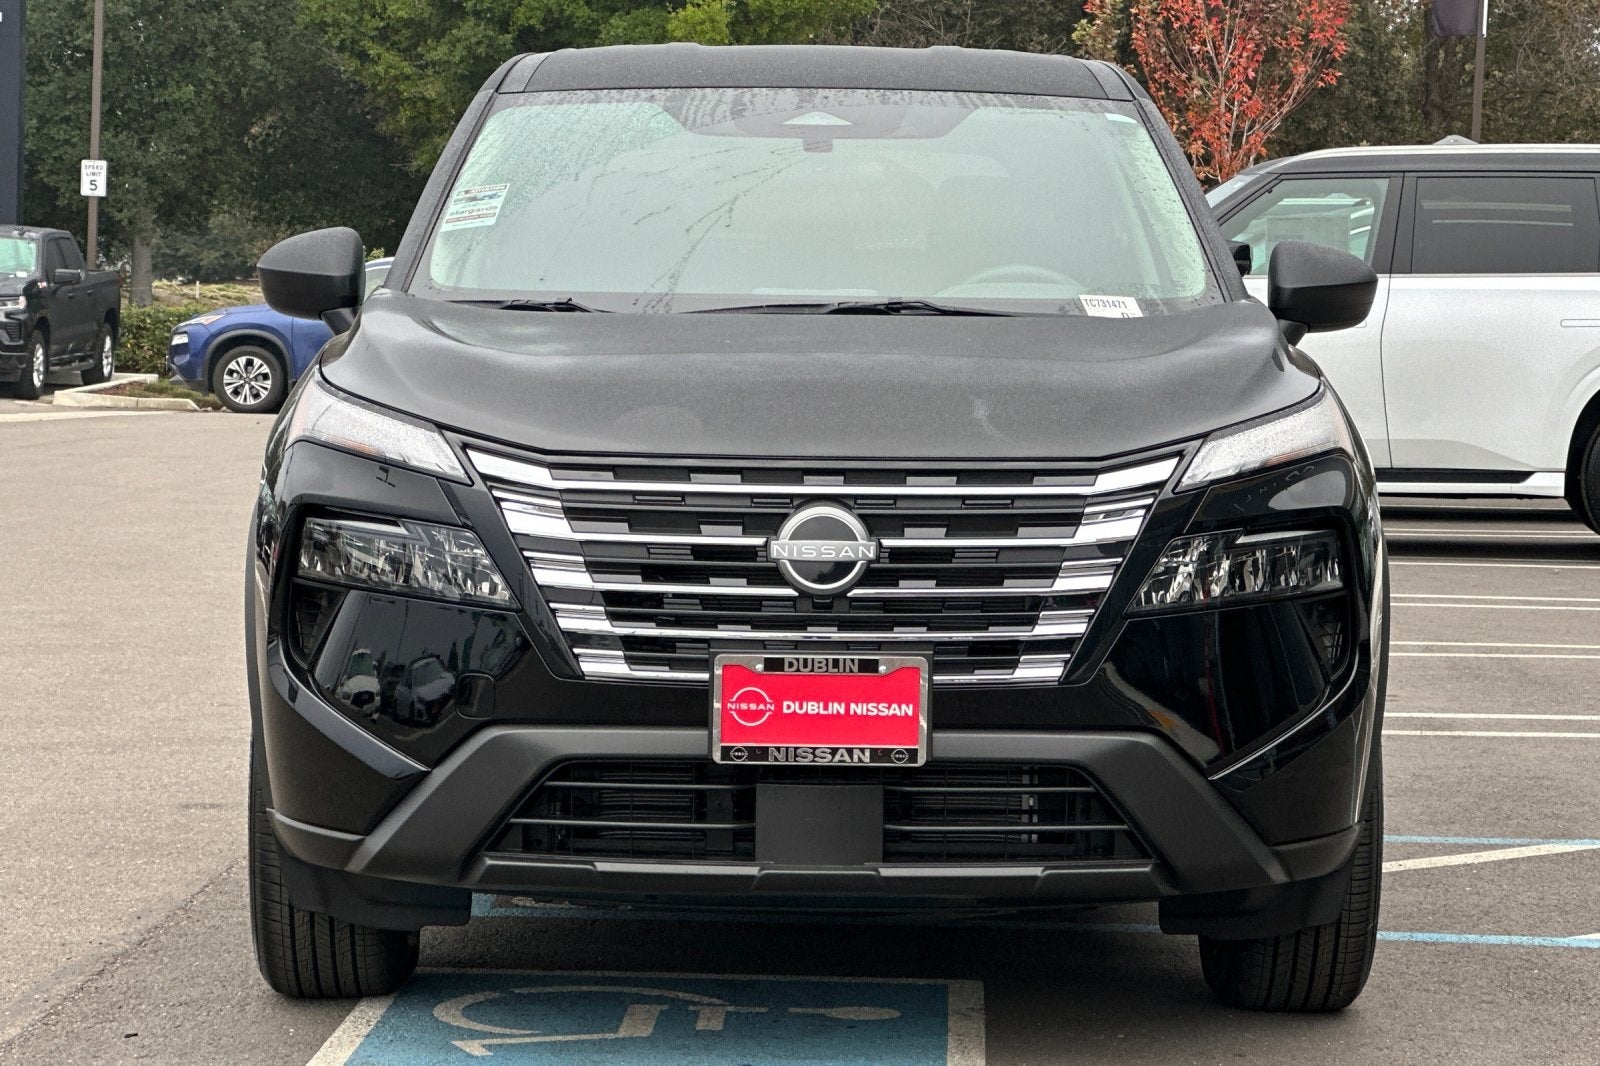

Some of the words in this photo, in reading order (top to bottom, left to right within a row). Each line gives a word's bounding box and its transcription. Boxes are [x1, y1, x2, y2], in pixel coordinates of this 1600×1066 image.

[89, 179, 98, 191] 5
[773, 544, 874, 558] NISSAN
[784, 657, 859, 673] DUBLIN
[727, 702, 775, 711] NISSAN
[782, 700, 845, 715] DUBLIN
[849, 702, 913, 717] NISSAN
[768, 747, 871, 763] NISSAN
